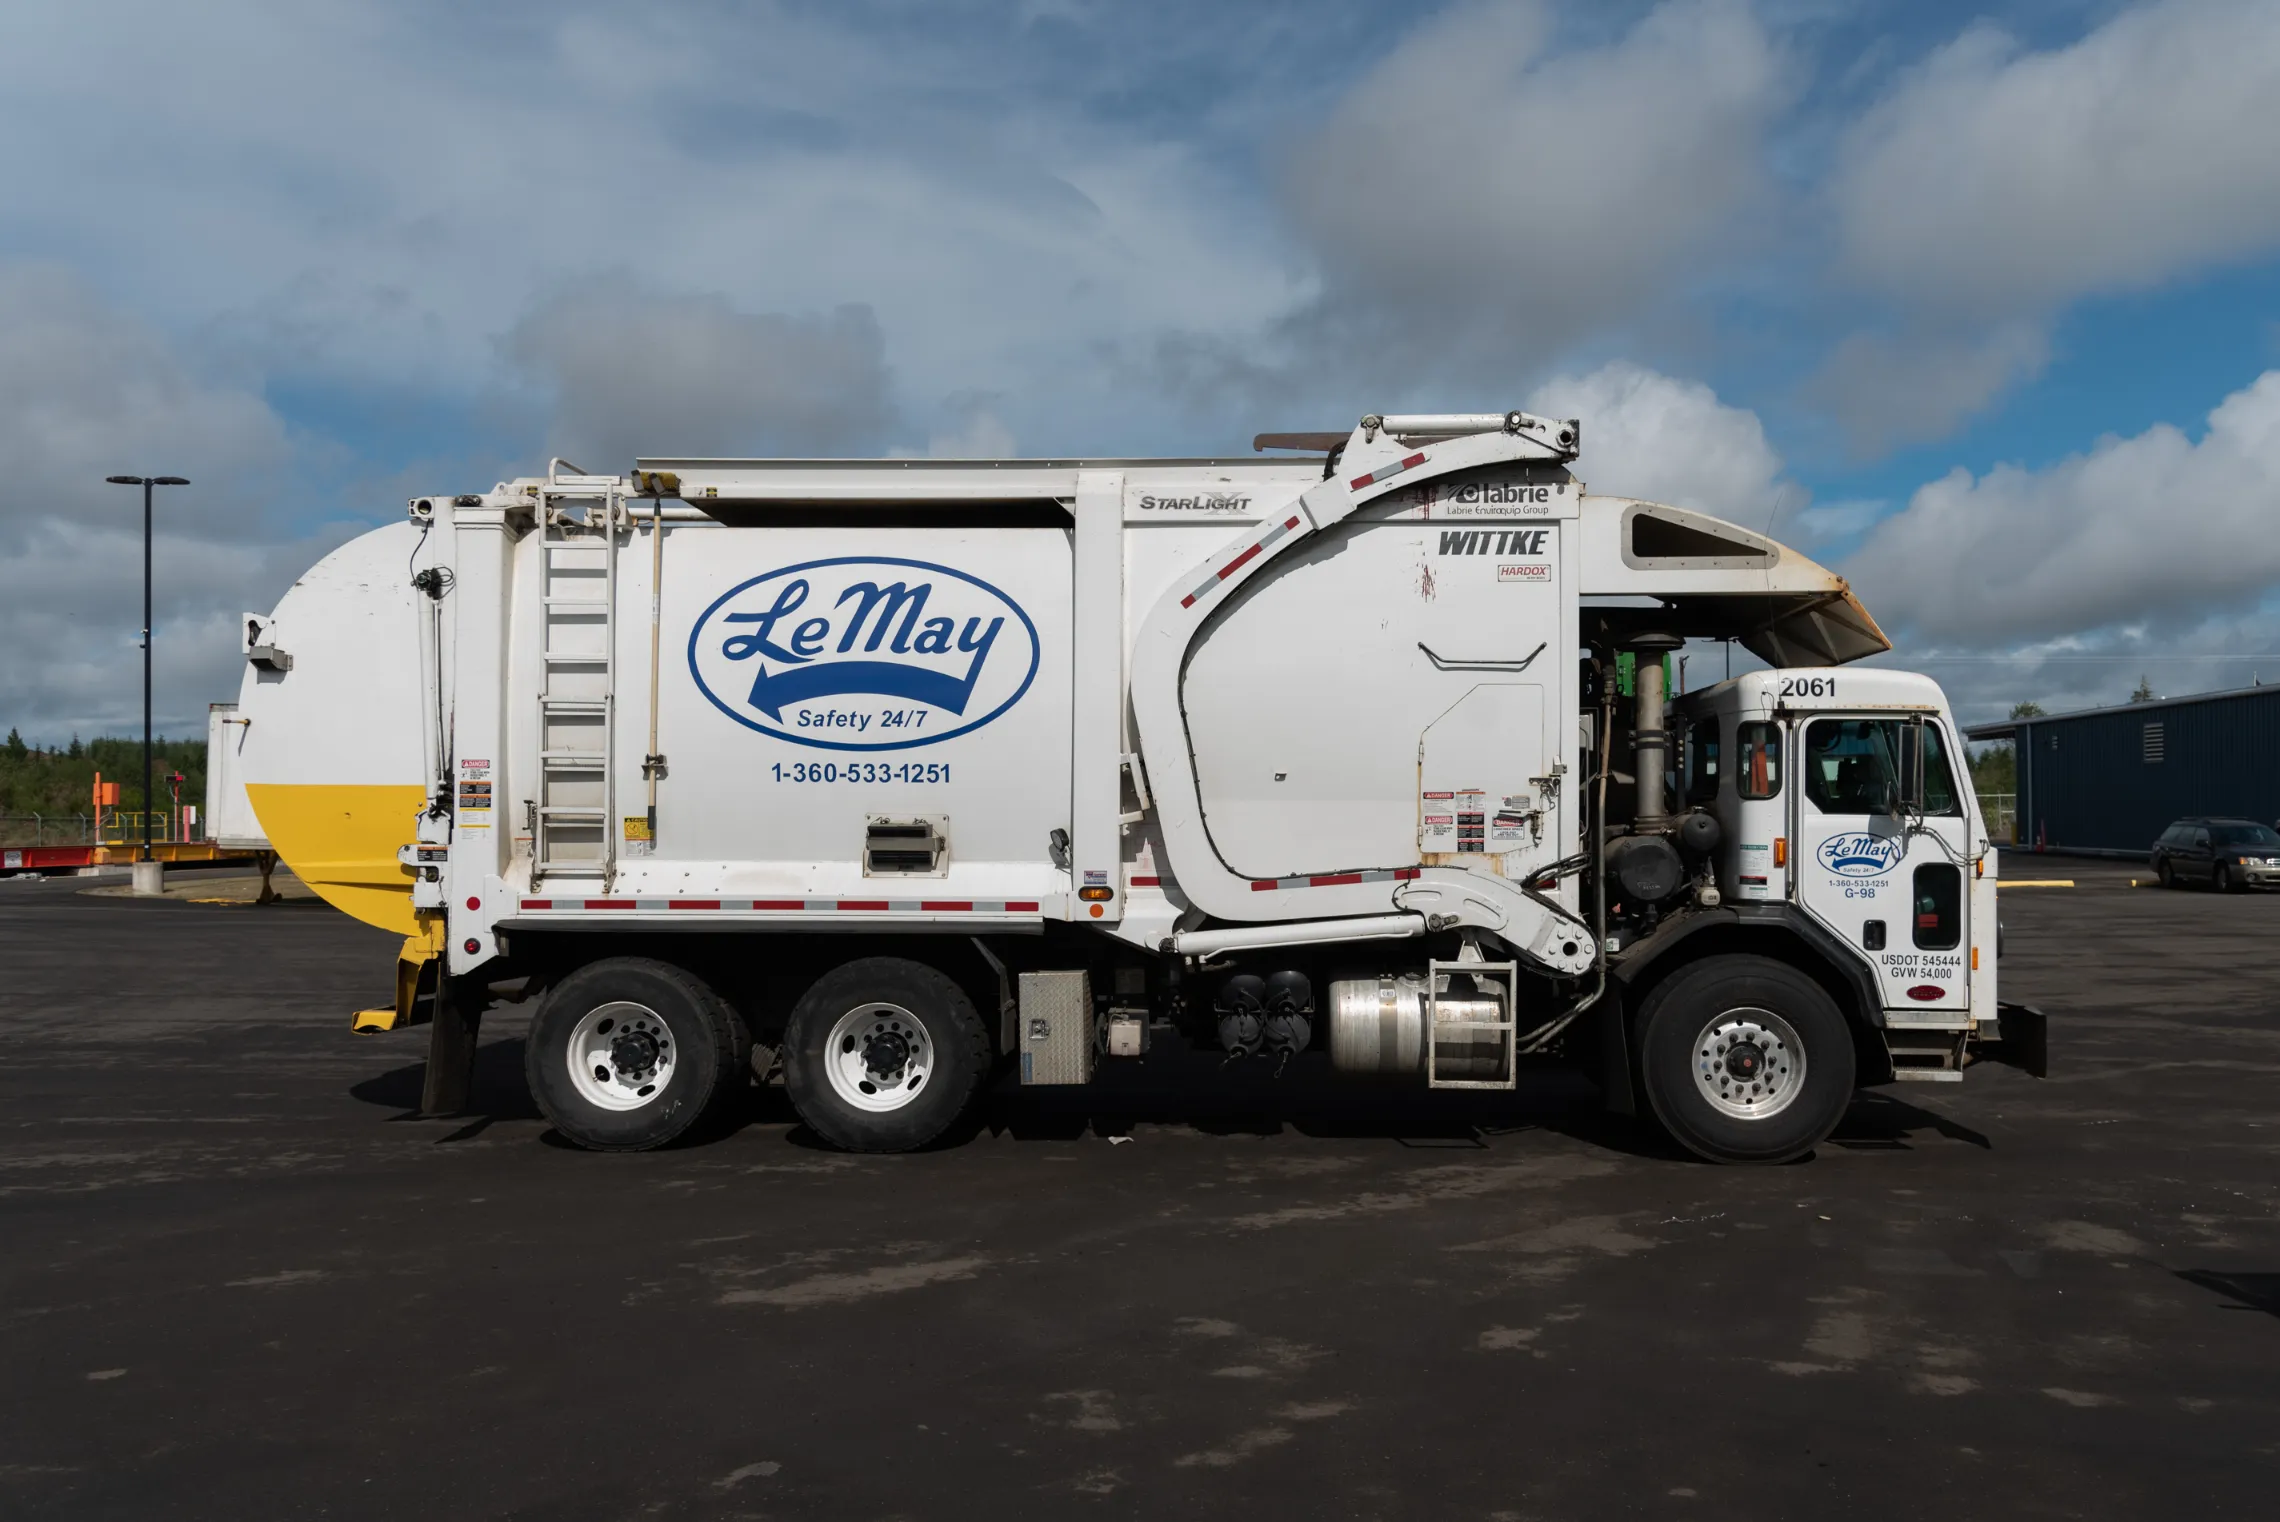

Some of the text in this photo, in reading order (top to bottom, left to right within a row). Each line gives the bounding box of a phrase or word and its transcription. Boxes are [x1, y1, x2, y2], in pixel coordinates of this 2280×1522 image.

[1483, 483, 1549, 503] labrie
[1447, 505, 1549, 516] Labrie Enviroquip Group
[1438, 530, 1549, 555] WITTKE
[1501, 567, 1546, 576] HARDOX
[1780, 677, 1836, 698] 2061
[797, 709, 928, 731] Safety 24/7
[771, 763, 951, 783] 1-360-533-1251
[1845, 888, 1875, 898] G-98
[1881, 954, 1961, 966] USDOT 545444
[1891, 967, 1952, 980] GVW 54,000
